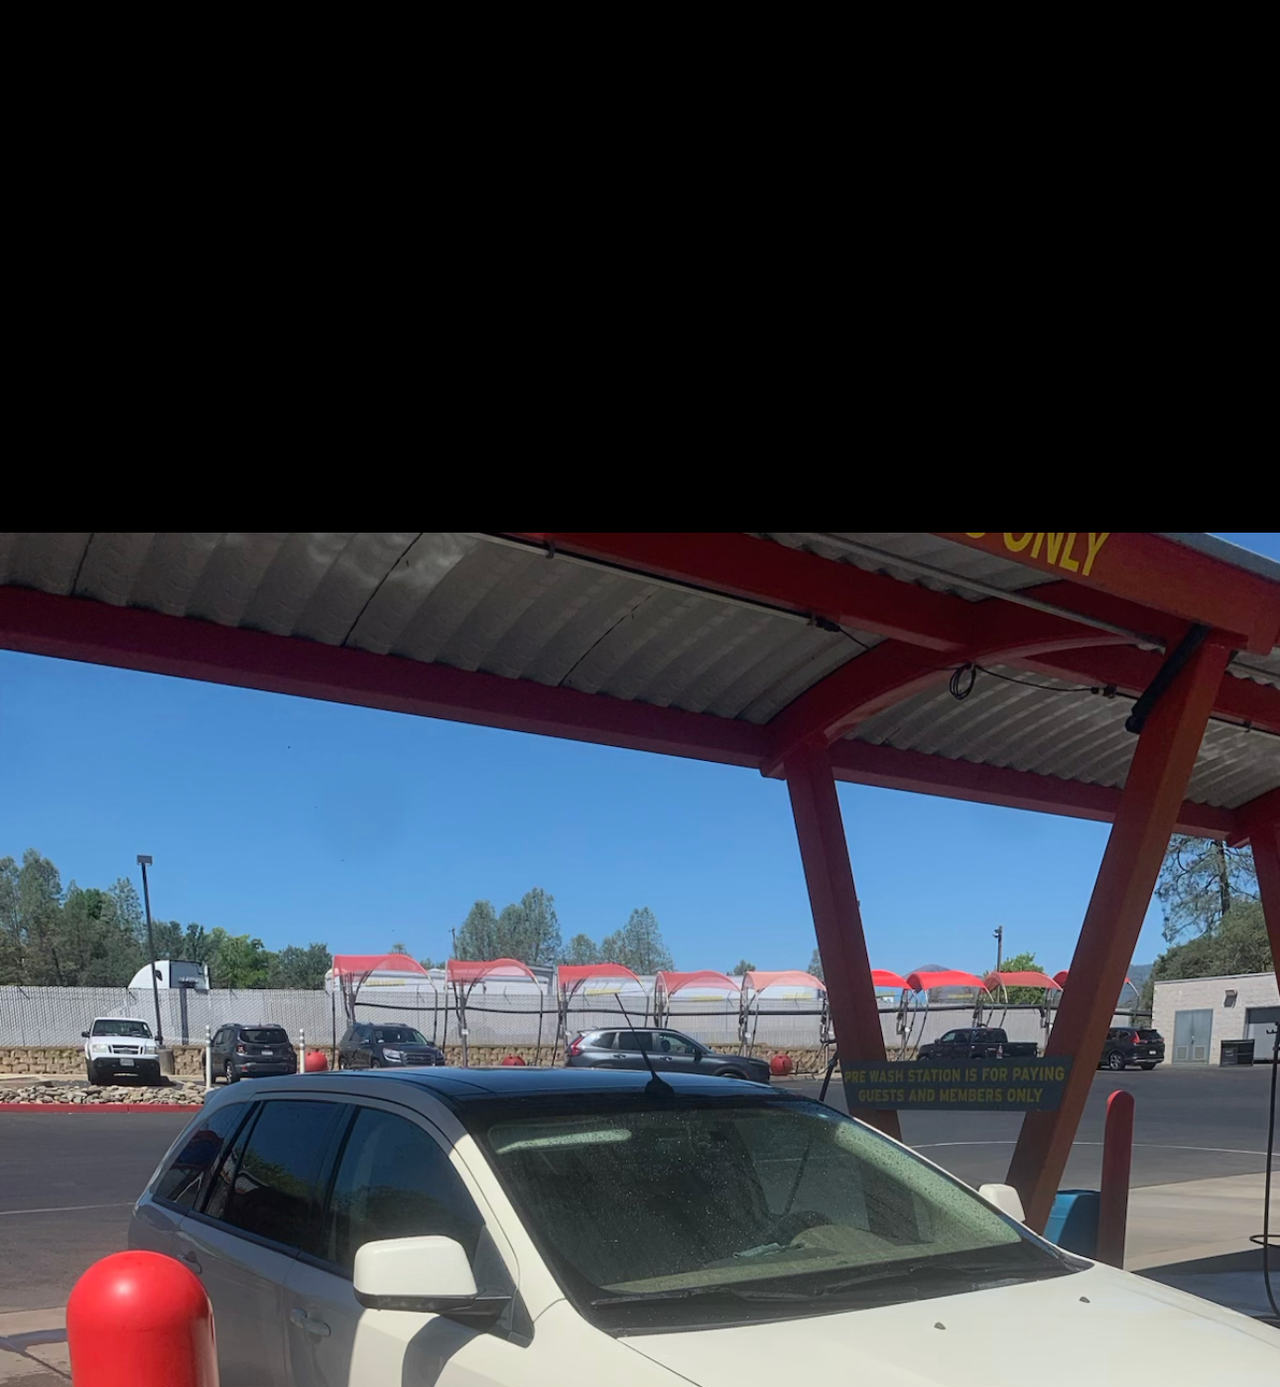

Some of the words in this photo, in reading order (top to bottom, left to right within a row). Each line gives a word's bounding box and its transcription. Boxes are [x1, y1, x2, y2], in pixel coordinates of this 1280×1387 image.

[845, 1071, 866, 1084] PRE
[870, 1069, 904, 1083] WASH
[908, 1068, 960, 1082] STATION
[965, 1068, 978, 1082] IS
[982, 1067, 1007, 1081] FOR
[1013, 1066, 1065, 1081] PAYING
[858, 1088, 905, 1102] GUESTS
[909, 1088, 935, 1102] AND
[939, 1088, 1002, 1102] MEMBERS
[1007, 1087, 1044, 1102] ONLY
